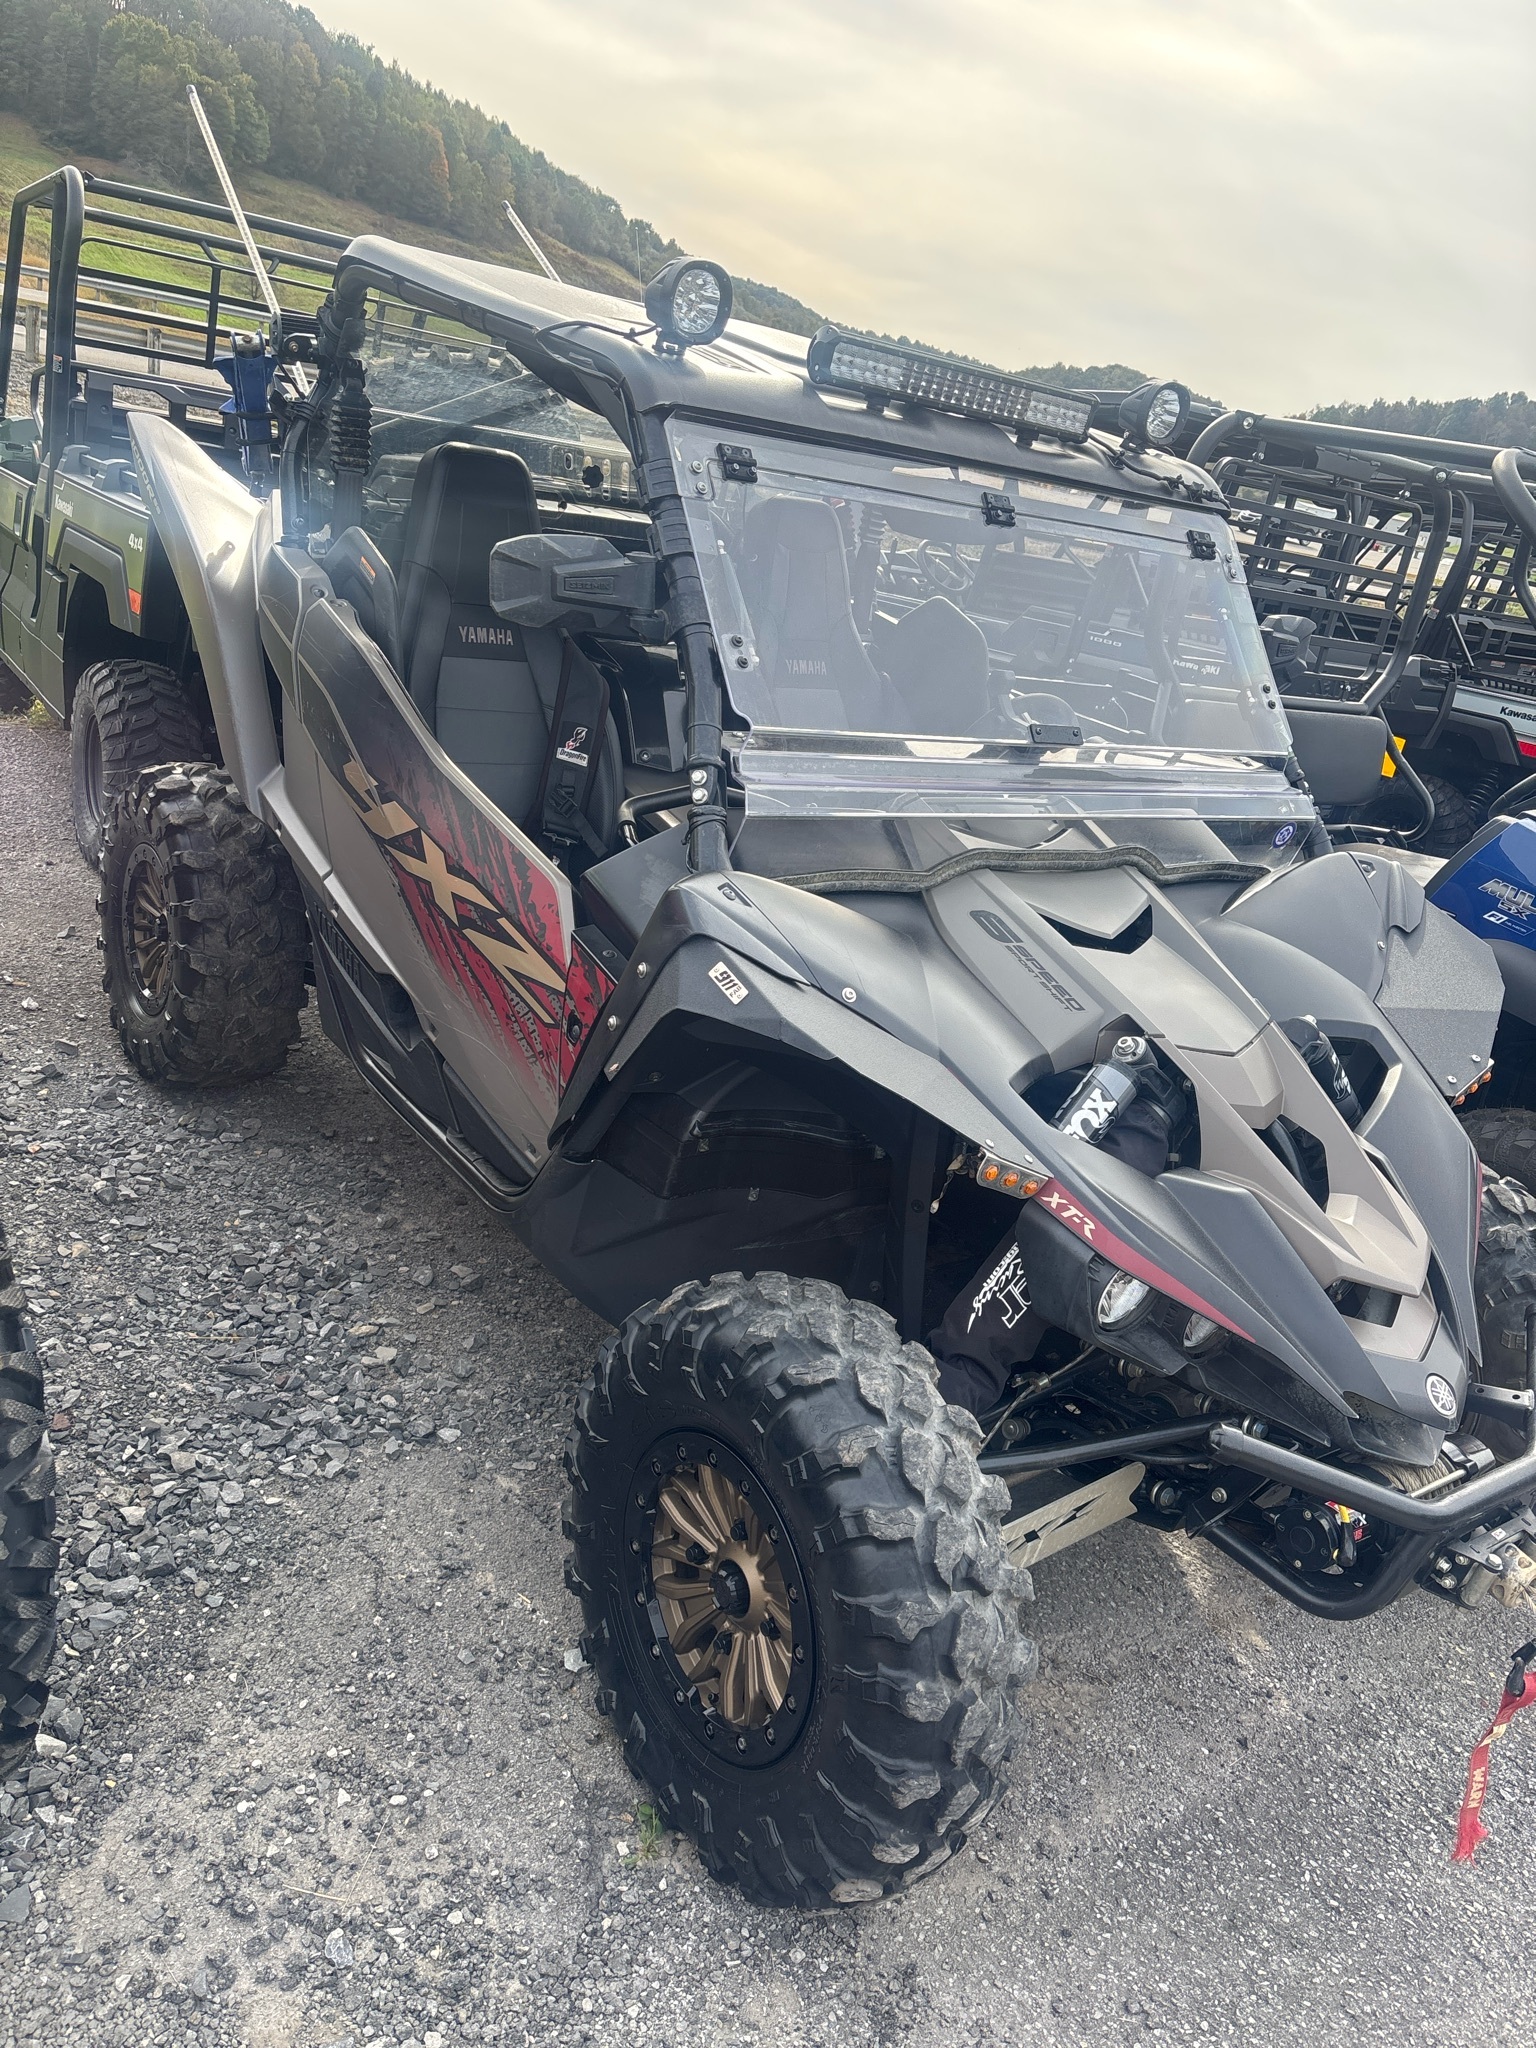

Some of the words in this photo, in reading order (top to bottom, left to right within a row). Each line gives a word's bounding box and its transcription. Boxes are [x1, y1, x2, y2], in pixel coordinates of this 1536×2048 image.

[128, 533, 144, 552] 4x4
[458, 625, 514, 646] YAMAHA
[1090, 635, 1122, 647] 1000
[785, 658, 827, 676] YAMAHA
[559, 748, 588, 762] DragonFire
[338, 753, 567, 1025] YXZ
[713, 970, 739, 992] 911
[1004, 945, 1042, 981] SPORT
[1038, 981, 1074, 1013] SHIFT
[1012, 944, 1087, 1012] SPEED
[1040, 1191, 1096, 1241] XT-R
[1466, 1766, 1486, 1809] WARN
